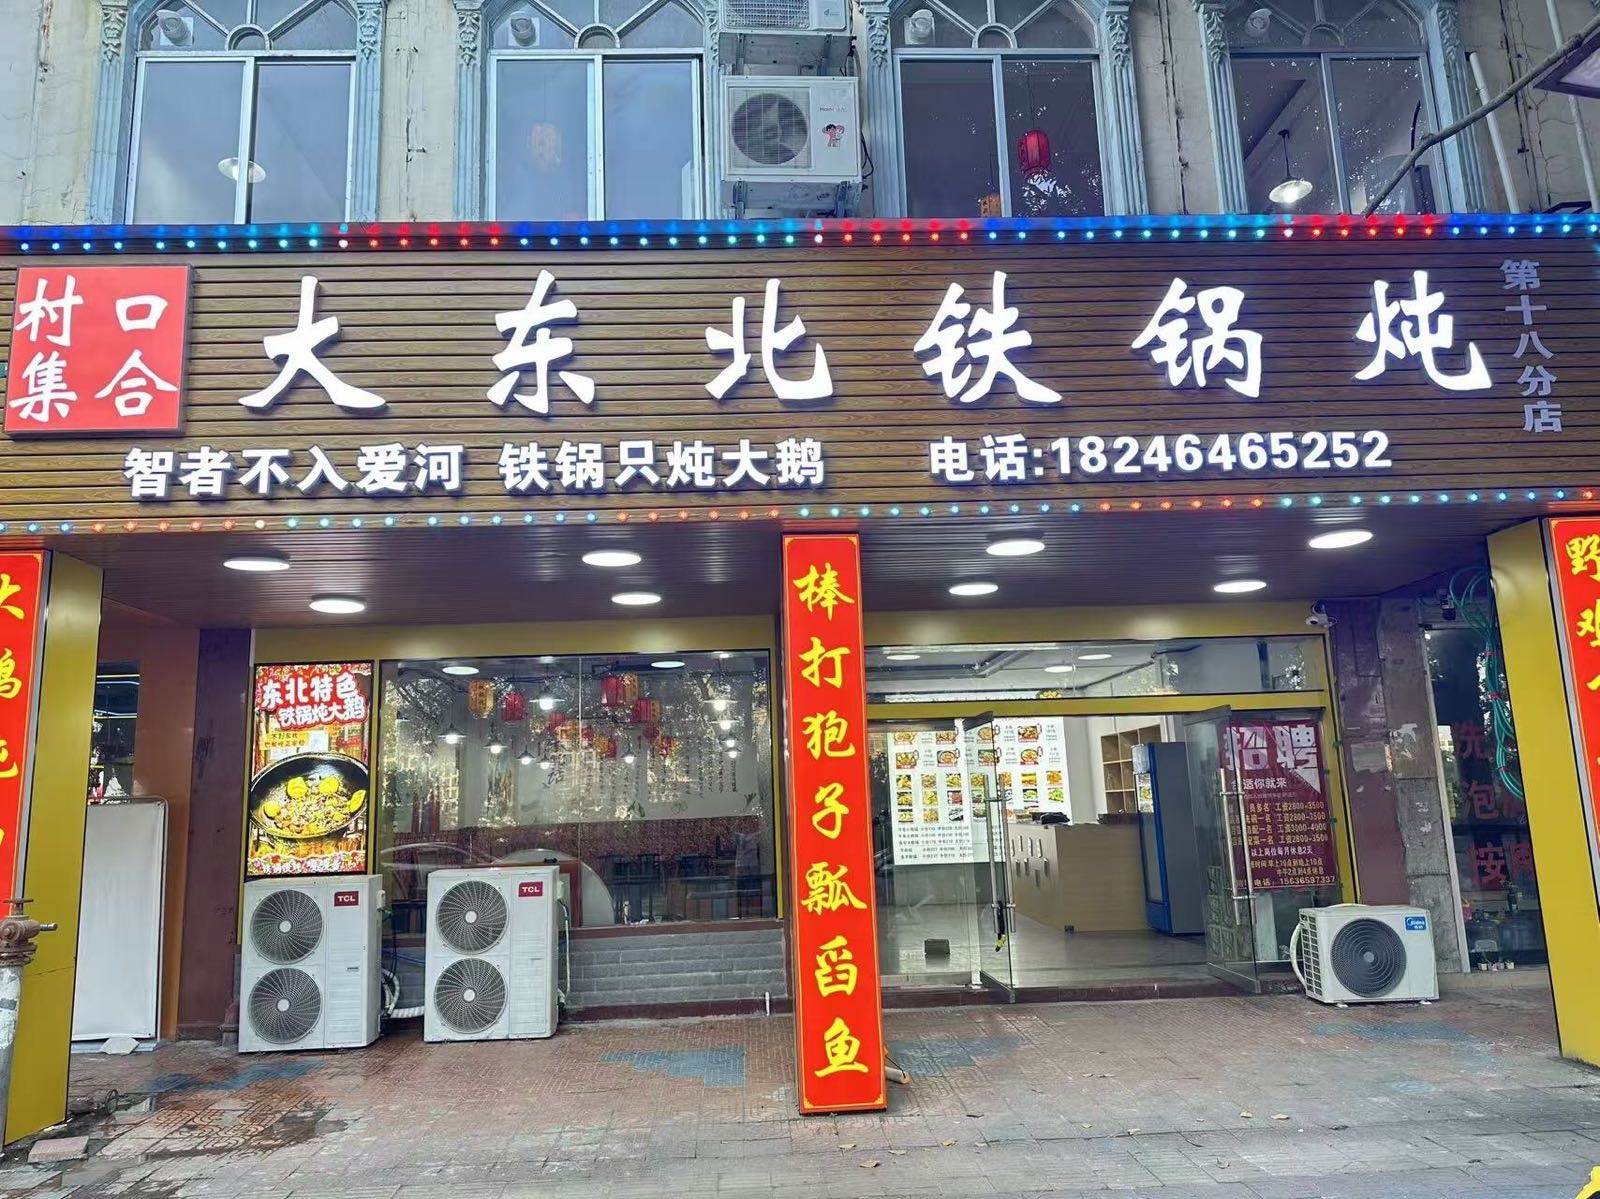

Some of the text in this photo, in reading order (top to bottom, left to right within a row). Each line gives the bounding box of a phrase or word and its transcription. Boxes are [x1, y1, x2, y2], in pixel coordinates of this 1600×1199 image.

[14, 274, 168, 347] 村口
[238, 270, 1493, 415] 大东北铁锅炖
[1500, 259, 1563, 434] 第十八分店
[9, 349, 179, 422] 集合
[124, 437, 826, 498] 智者不入爱河 铁锅只炖大鹅
[929, 429, 1393, 482] 电话:18246465252
[262, 672, 358, 709] 东北特色
[278, 694, 365, 729] 铁锅炖大鹅
[1223, 724, 1321, 790] 招聘
[793, 562, 868, 1078] 棒打狍子瓢舀鱼
[336, 895, 356, 903] TCL
[522, 885, 540, 894] TCL
